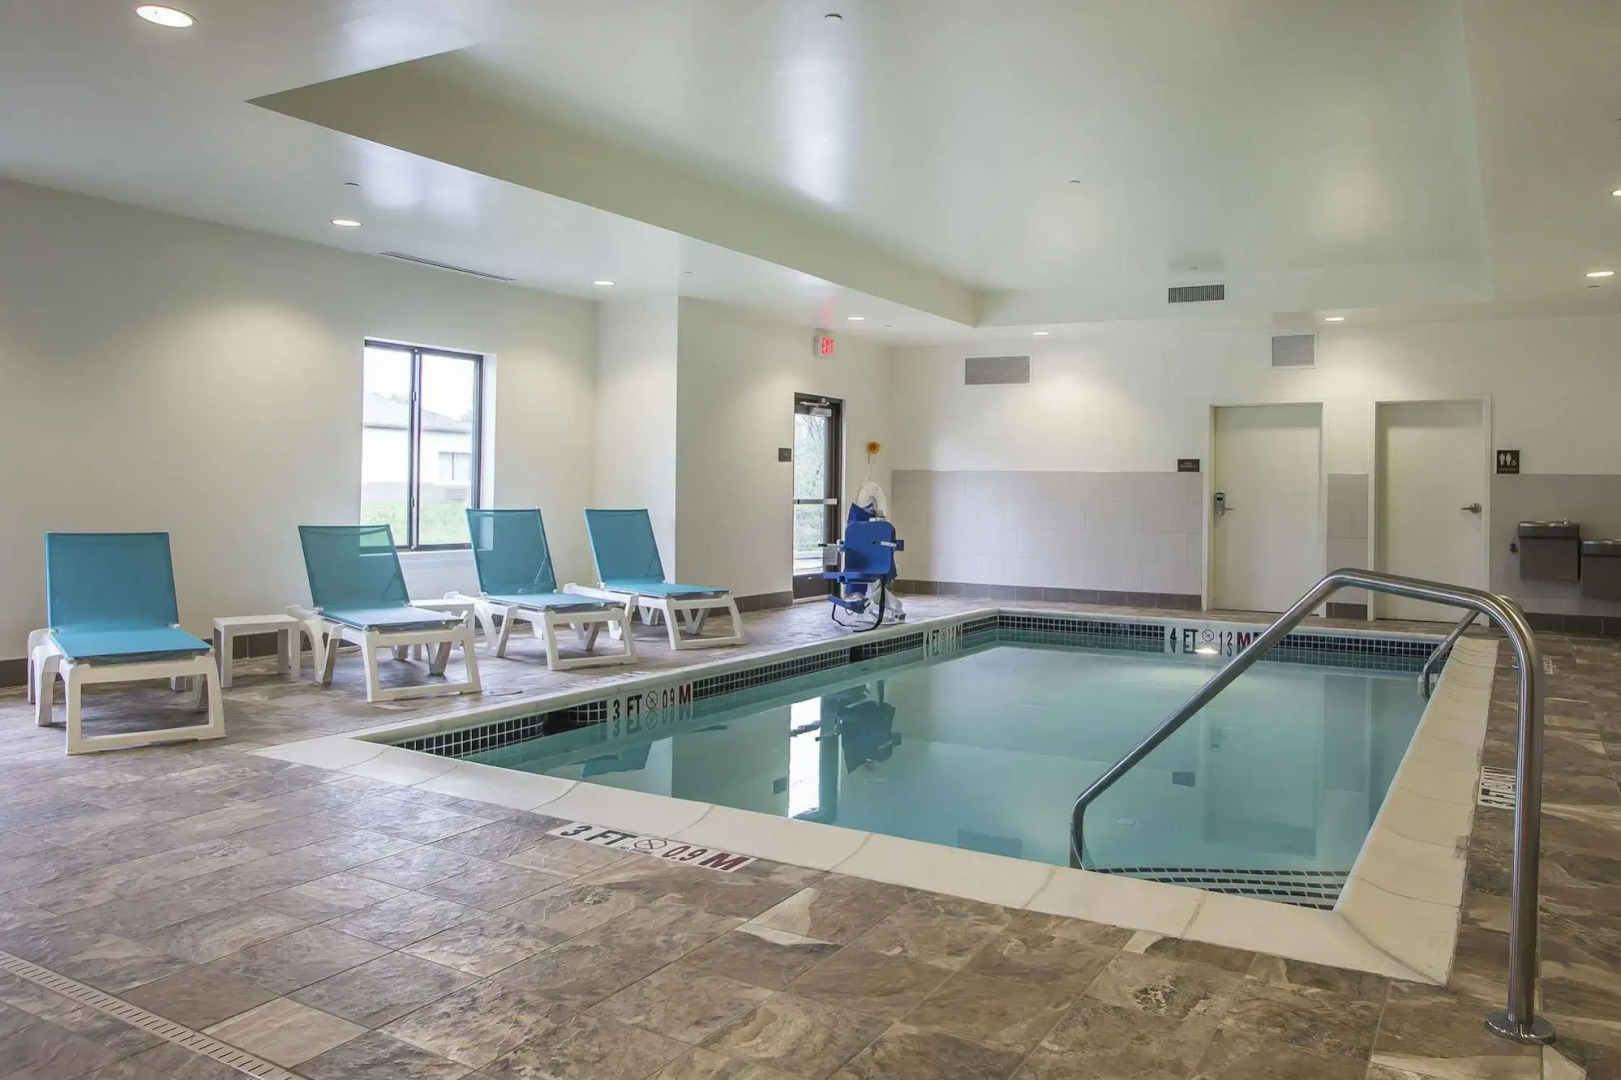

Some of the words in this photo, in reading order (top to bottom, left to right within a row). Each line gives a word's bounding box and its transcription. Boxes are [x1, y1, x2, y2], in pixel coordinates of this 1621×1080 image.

[613, 699, 620, 722] 3
[627, 694, 642, 718] FT
[679, 684, 691, 704] M
[560, 825, 593, 837] 3
[584, 830, 639, 846] FT
[661, 845, 708, 862] 0.9
[698, 852, 751, 871] M
